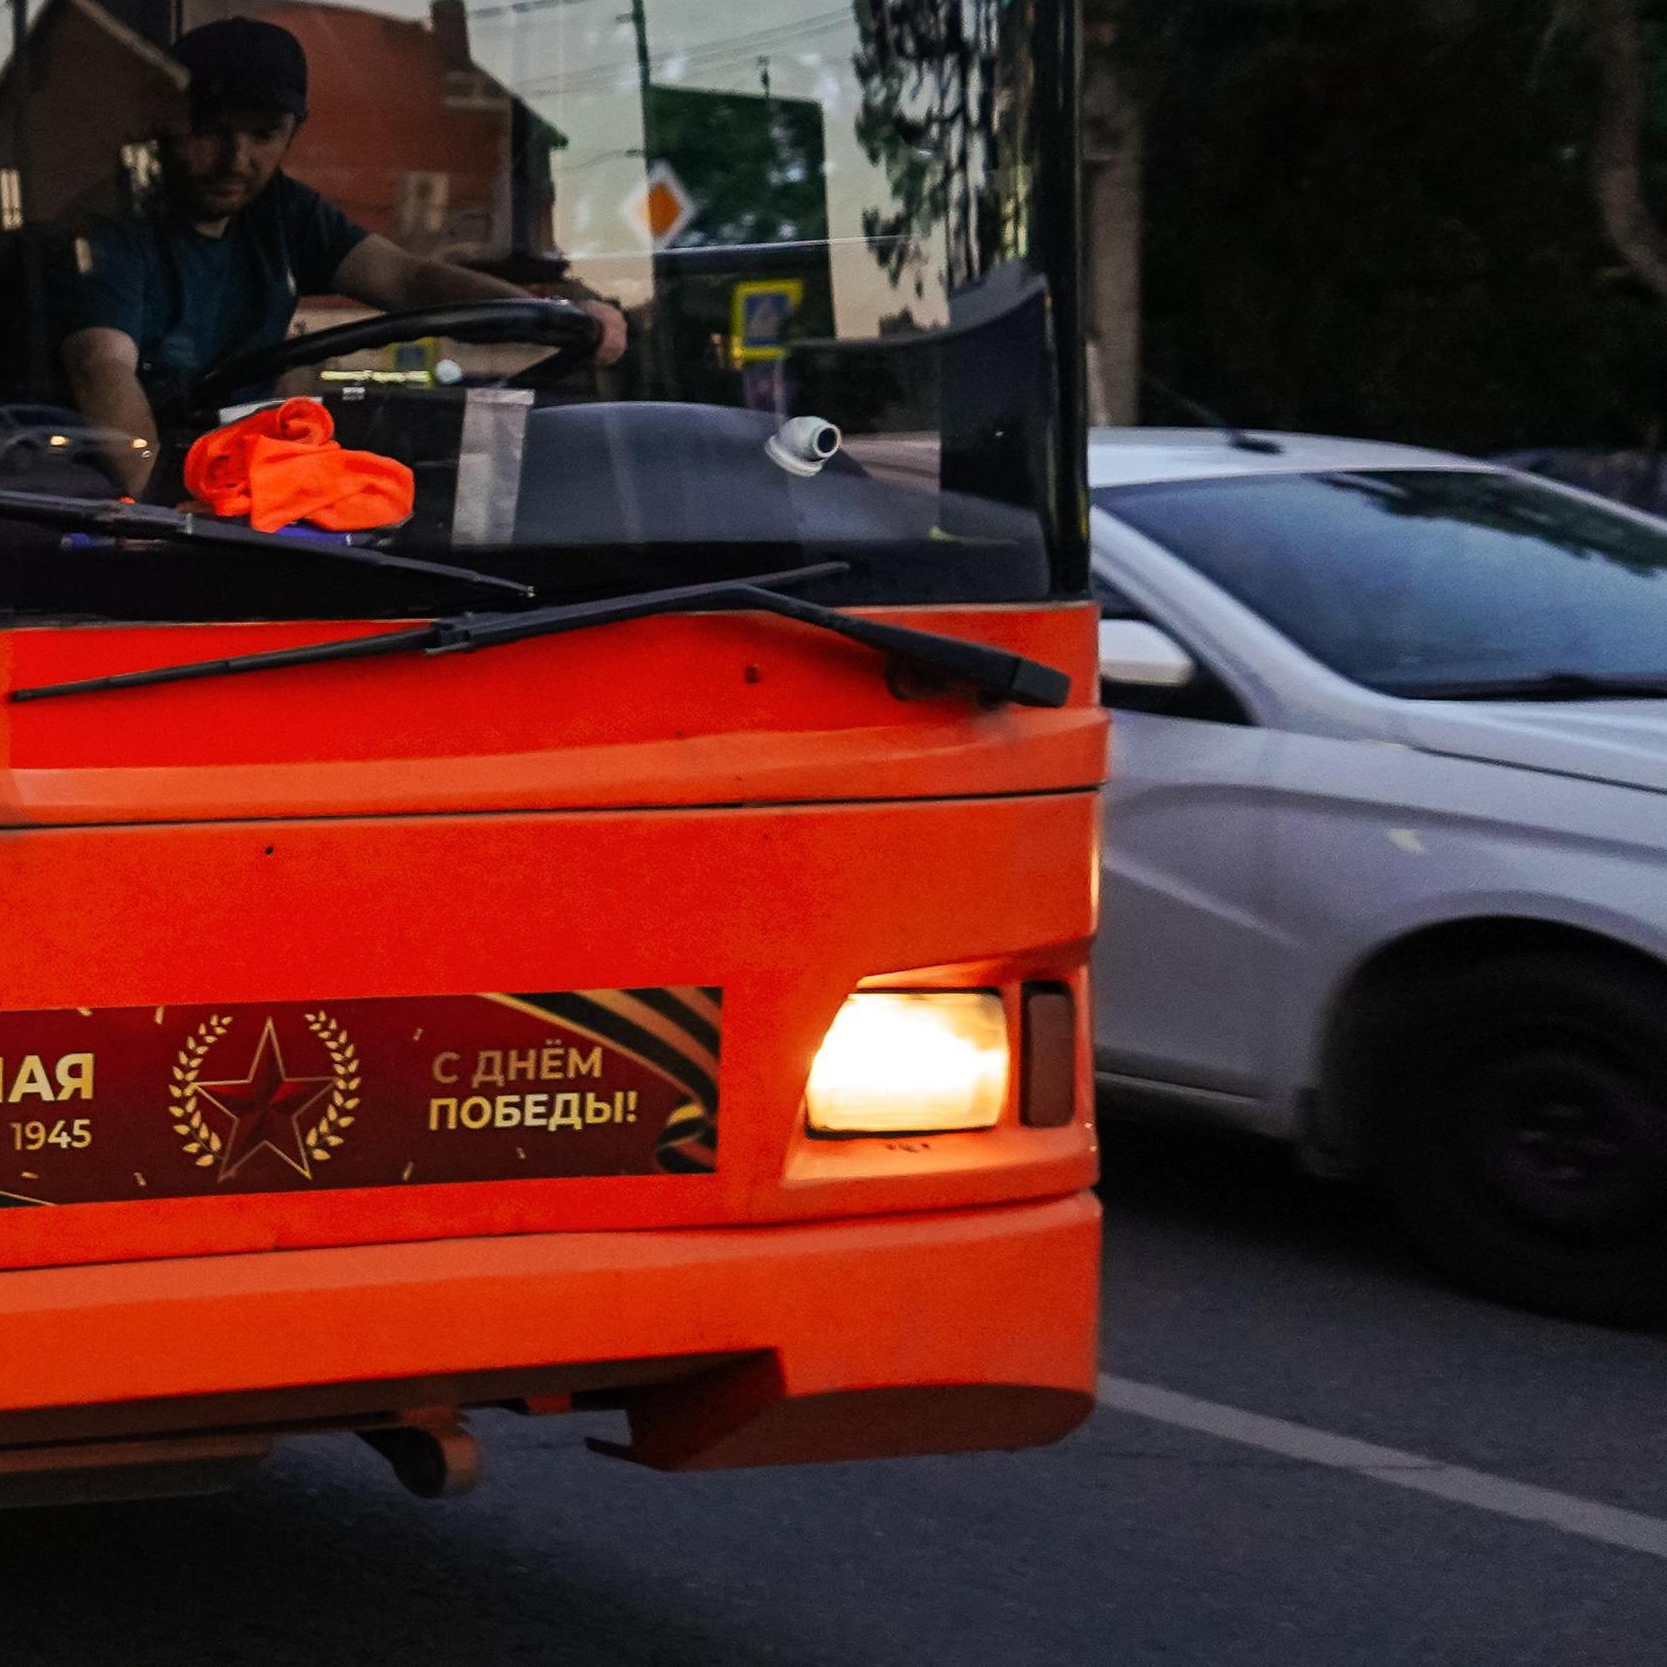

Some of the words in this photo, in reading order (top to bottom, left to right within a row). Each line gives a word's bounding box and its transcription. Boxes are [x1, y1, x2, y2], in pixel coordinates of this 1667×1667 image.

[432, 1051, 460, 1084] С
[471, 1038, 603, 1088] ДНЁМ
[429, 1091, 639, 1132] ПОБЕДЫ!
[10, 1119, 92, 1151] 1945
